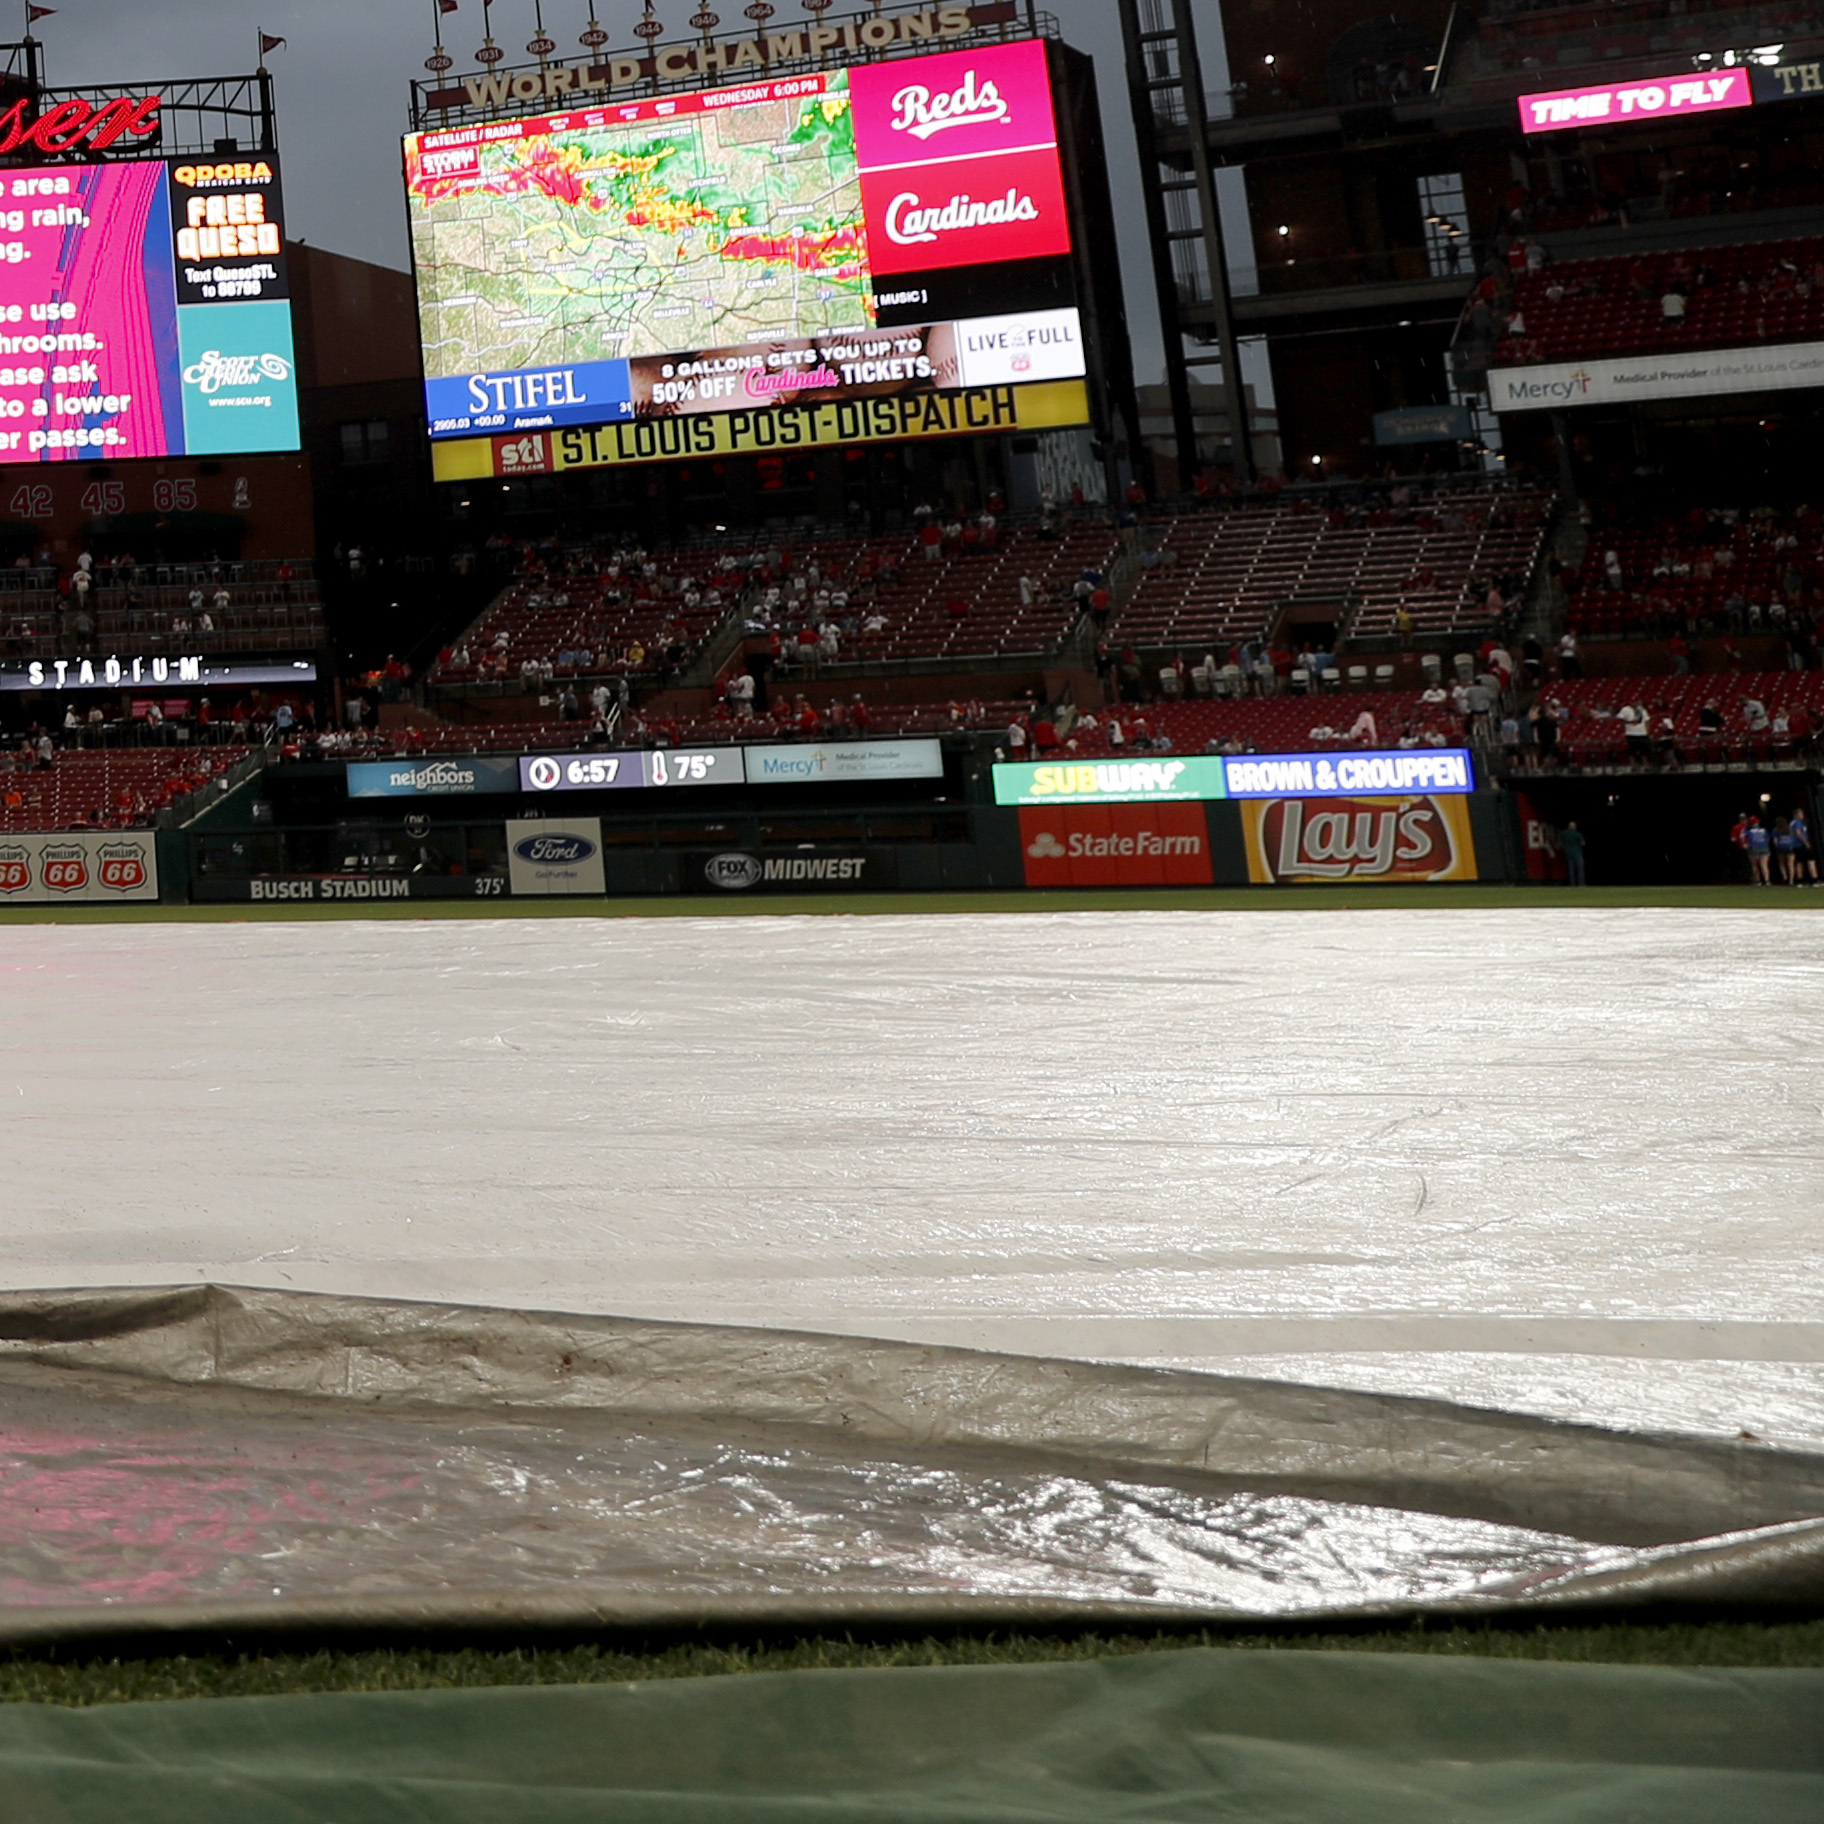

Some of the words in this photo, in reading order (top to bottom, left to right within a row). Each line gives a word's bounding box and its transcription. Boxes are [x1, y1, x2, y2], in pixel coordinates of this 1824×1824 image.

[425, 56, 450, 69] 1926
[477, 49, 500, 62] 1931
[580, 32, 605, 44] 1942
[634, 24, 661, 36] 1944
[691, 13, 719, 26] 1946
[745, 4, 773, 18] 1964
[463, 57, 641, 109] WORLD
[654, 6, 972, 81] CHAMPIONS
[703, 86, 770, 107] WEDNESDAY
[774, 81, 799, 97] 6:00
[801, 79, 819, 93] PM
[1530, 92, 1612, 125] TIME
[1616, 85, 1665, 113] TO
[1669, 76, 1735, 108] FLY
[485, 124, 523, 138] RADAR
[12, 176, 70, 197] area
[174, 161, 273, 188] QDOBA
[31, 204, 91, 229] rain,
[186, 191, 266, 228] FREE
[885, 188, 1039, 245] Cardinals
[176, 222, 281, 263] QUESO
[184, 267, 212, 284] Text
[30, 301, 77, 322] use
[967, 329, 1010, 352] LIVE
[1027, 325, 1074, 346] FULL
[51, 359, 99, 384] ask
[677, 355, 765, 377] GALLONS
[767, 349, 817, 369] GETS
[820, 345, 860, 363] YOU
[468, 370, 587, 414] STIFEL
[652, 378, 696, 405] 50%
[699, 375, 736, 399] OFF
[1507, 378, 1574, 401] Mercy
[1660, 368, 1708, 382] Provider
[561, 426, 609, 465] ST.
[615, 416, 716, 460] LOUIS
[730, 387, 1018, 449] POST-DISPATCH
[502, 462, 545, 473] today.com
[10, 484, 54, 519] 42
[81, 480, 126, 516] 45
[153, 478, 198, 513] 85
[389, 762, 475, 789] neighbors
[567, 758, 621, 785] 6:57
[763, 755, 815, 777] Mercy
[1225, 760, 1314, 793] BROWN
[1337, 755, 1468, 789] CROUPPEN
[45, 847, 82, 860] PHILLIPS
[103, 846, 140, 859] PHILLIPS
[48, 863, 80, 883] 66
[106, 862, 138, 882] 66
[717, 859, 750, 876] FOX
[763, 858, 866, 881] MIDWEST
[250, 880, 315, 900] BUSCH
[320, 878, 411, 899] STADIUM
